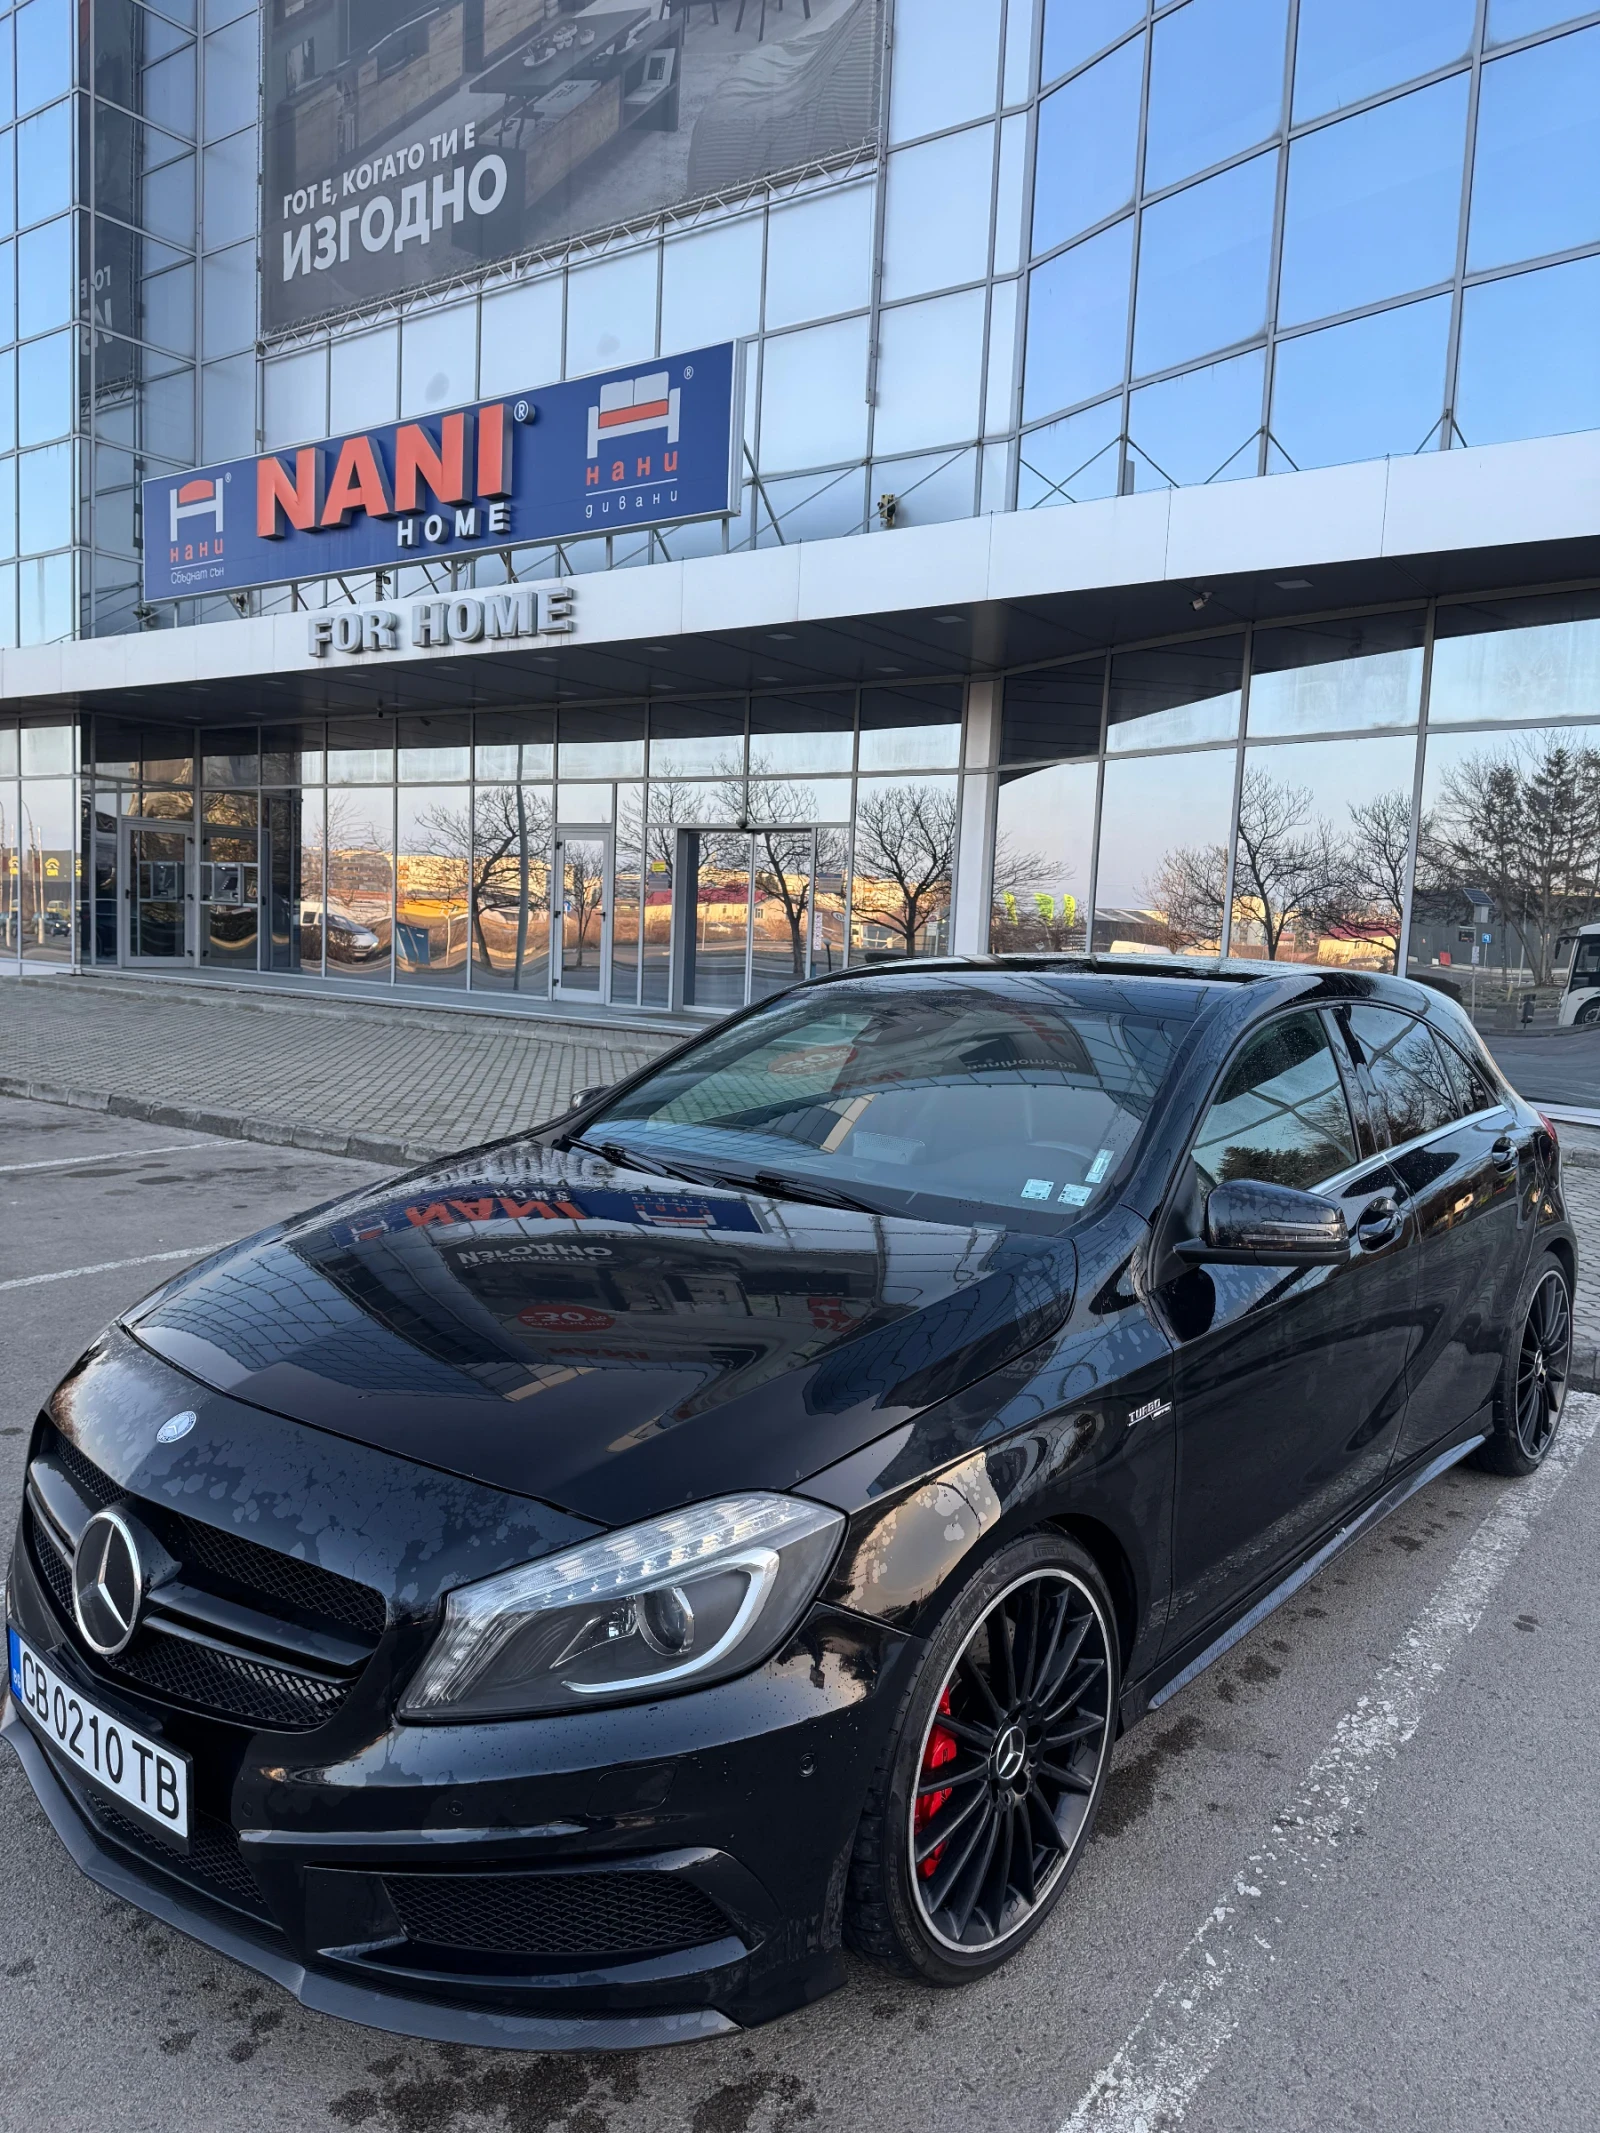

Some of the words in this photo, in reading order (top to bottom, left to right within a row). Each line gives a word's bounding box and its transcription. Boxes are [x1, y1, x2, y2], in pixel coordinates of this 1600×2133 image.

[283, 184, 318, 219] ГОТ
[322, 178, 338, 205] Е,
[343, 143, 425, 197] КОГАТО
[430, 128, 458, 162] ТИ
[464, 121, 476, 150] Е
[283, 154, 508, 282] ИЗГОДНО
[257, 403, 513, 540] NANI
[586, 450, 678, 486] нани
[397, 502, 512, 548] HOME
[585, 490, 678, 519] дивани
[170, 538, 224, 563] нани
[170, 569, 208, 585] Сбъднат
[209, 566, 225, 577] сън
[308, 609, 398, 657] FOR
[412, 585, 575, 647] HOME
[22, 1650, 50, 1723] CB
[53, 1685, 124, 1785] 0210
[131, 1739, 180, 1821] TB
